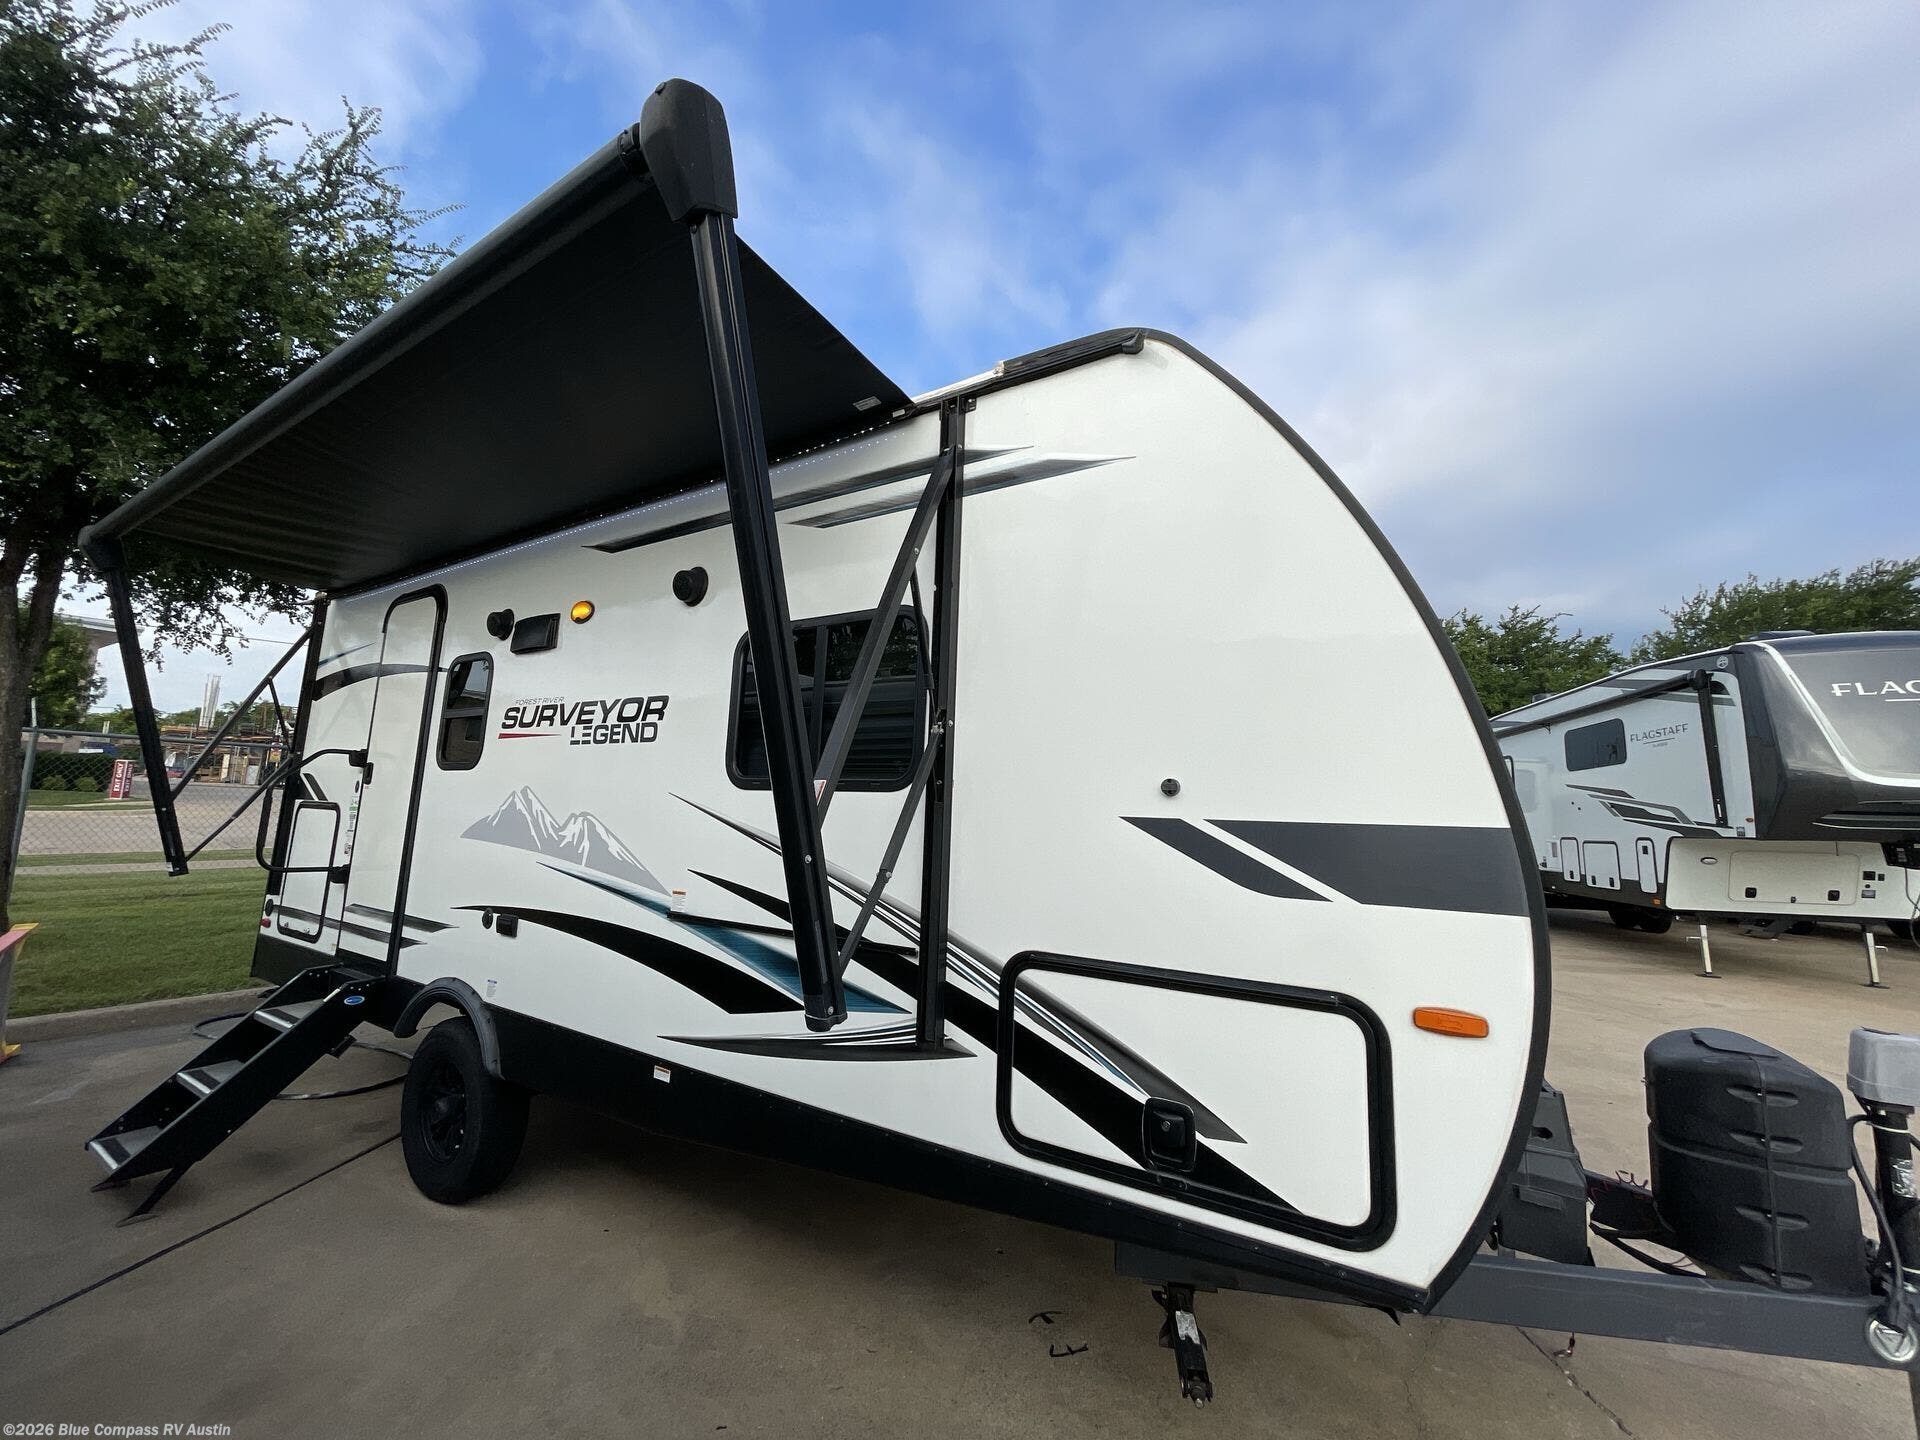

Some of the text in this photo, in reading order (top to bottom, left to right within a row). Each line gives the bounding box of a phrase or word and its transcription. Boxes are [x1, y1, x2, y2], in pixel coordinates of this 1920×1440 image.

[501, 695, 670, 729] SURVEYOR
[543, 696, 566, 704] RIVER
[570, 722, 658, 746] LEGEND
[1630, 723, 1688, 742] FLAGSTAFF
[113, 762, 124, 792] EXIT ONLY
